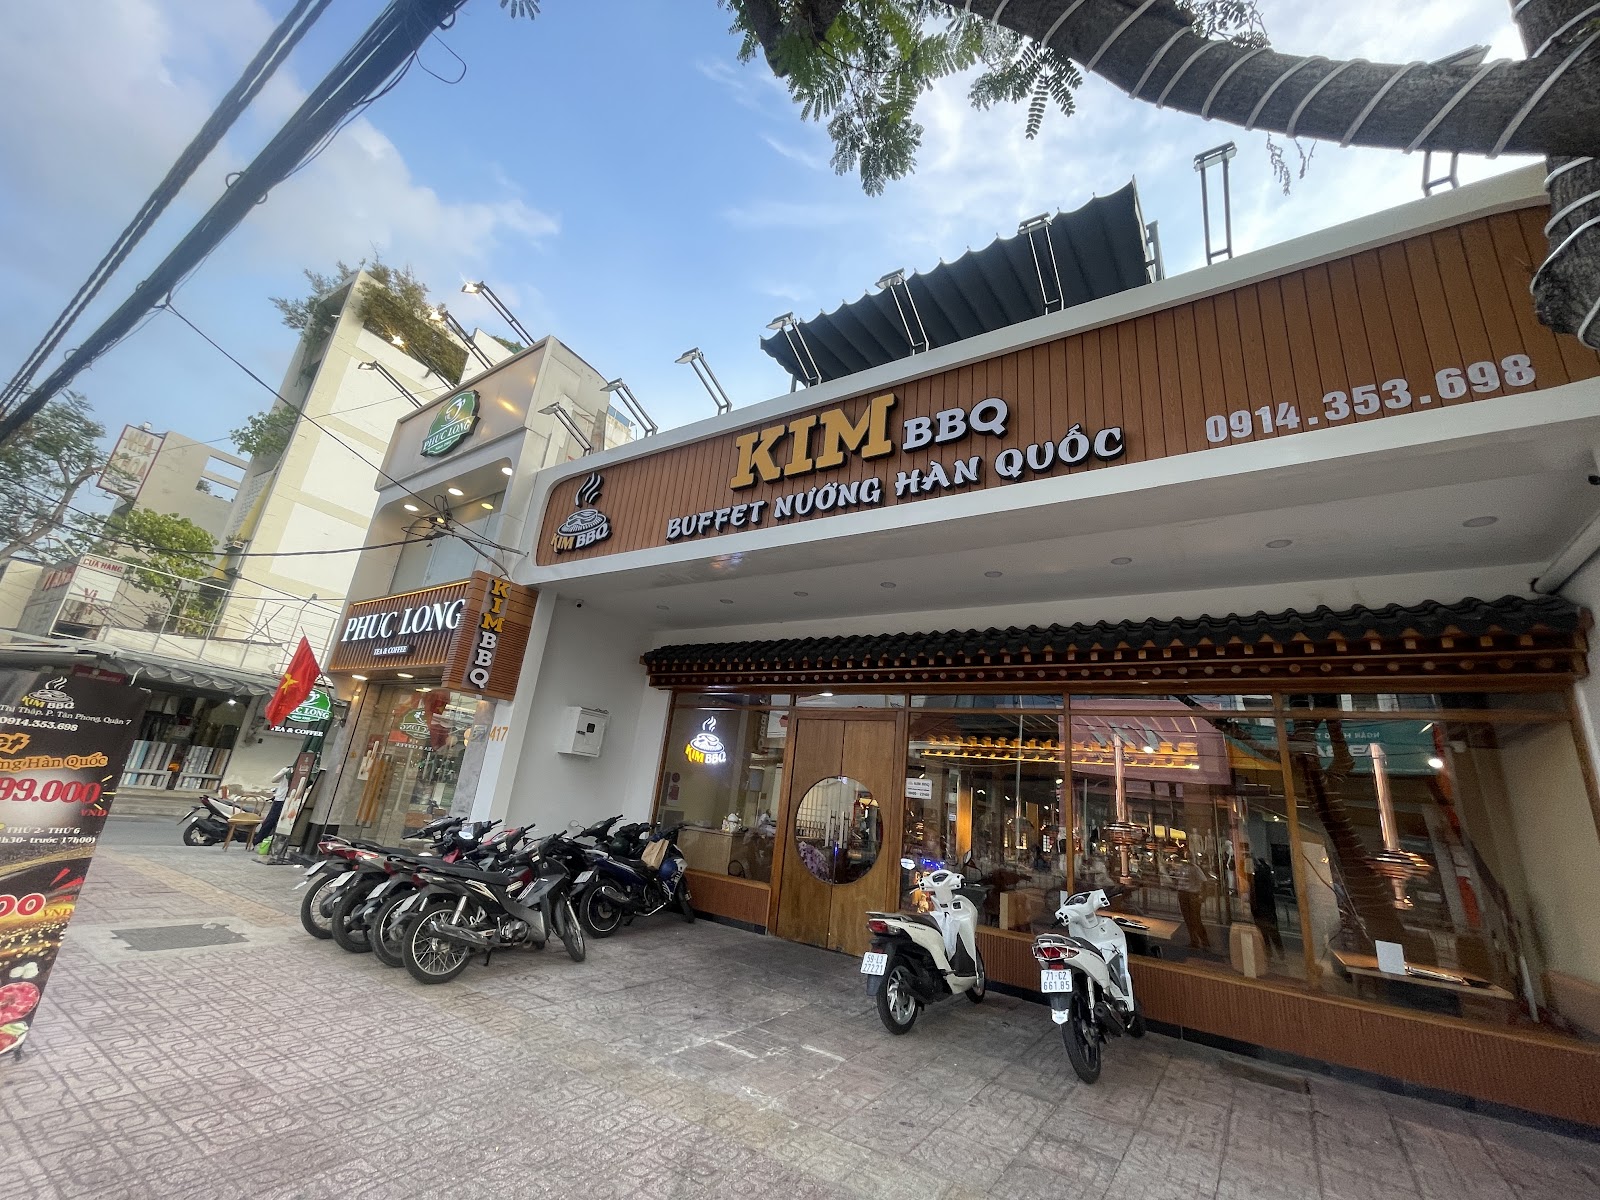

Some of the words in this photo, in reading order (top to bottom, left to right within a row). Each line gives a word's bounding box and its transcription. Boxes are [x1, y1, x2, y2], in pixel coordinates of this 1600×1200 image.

[1206, 354, 1536, 442] 0914.353.698
[730, 393, 897, 490] KIM
[902, 398, 1009, 450] BBQ
[666, 501, 765, 540] BUFFET
[774, 477, 882, 518] NƯỚNG
[895, 456, 981, 496] HÀN
[994, 423, 1124, 478] QUỐC
[550, 533, 575, 552] KIM
[575, 523, 609, 548] BBQ
[341, 612, 398, 642] PHUC
[398, 599, 466, 635] LONG
[481, 580, 510, 633] KIM
[470, 631, 497, 689] BBQ
[22, 696, 45, 708] KIM
[294, 729, 324, 737] COFFEE
[489, 726, 508, 741] 417
[66, 754, 106, 769] Quốc
[685, 744, 705, 764] KIM
[705, 752, 727, 764] BBQ
